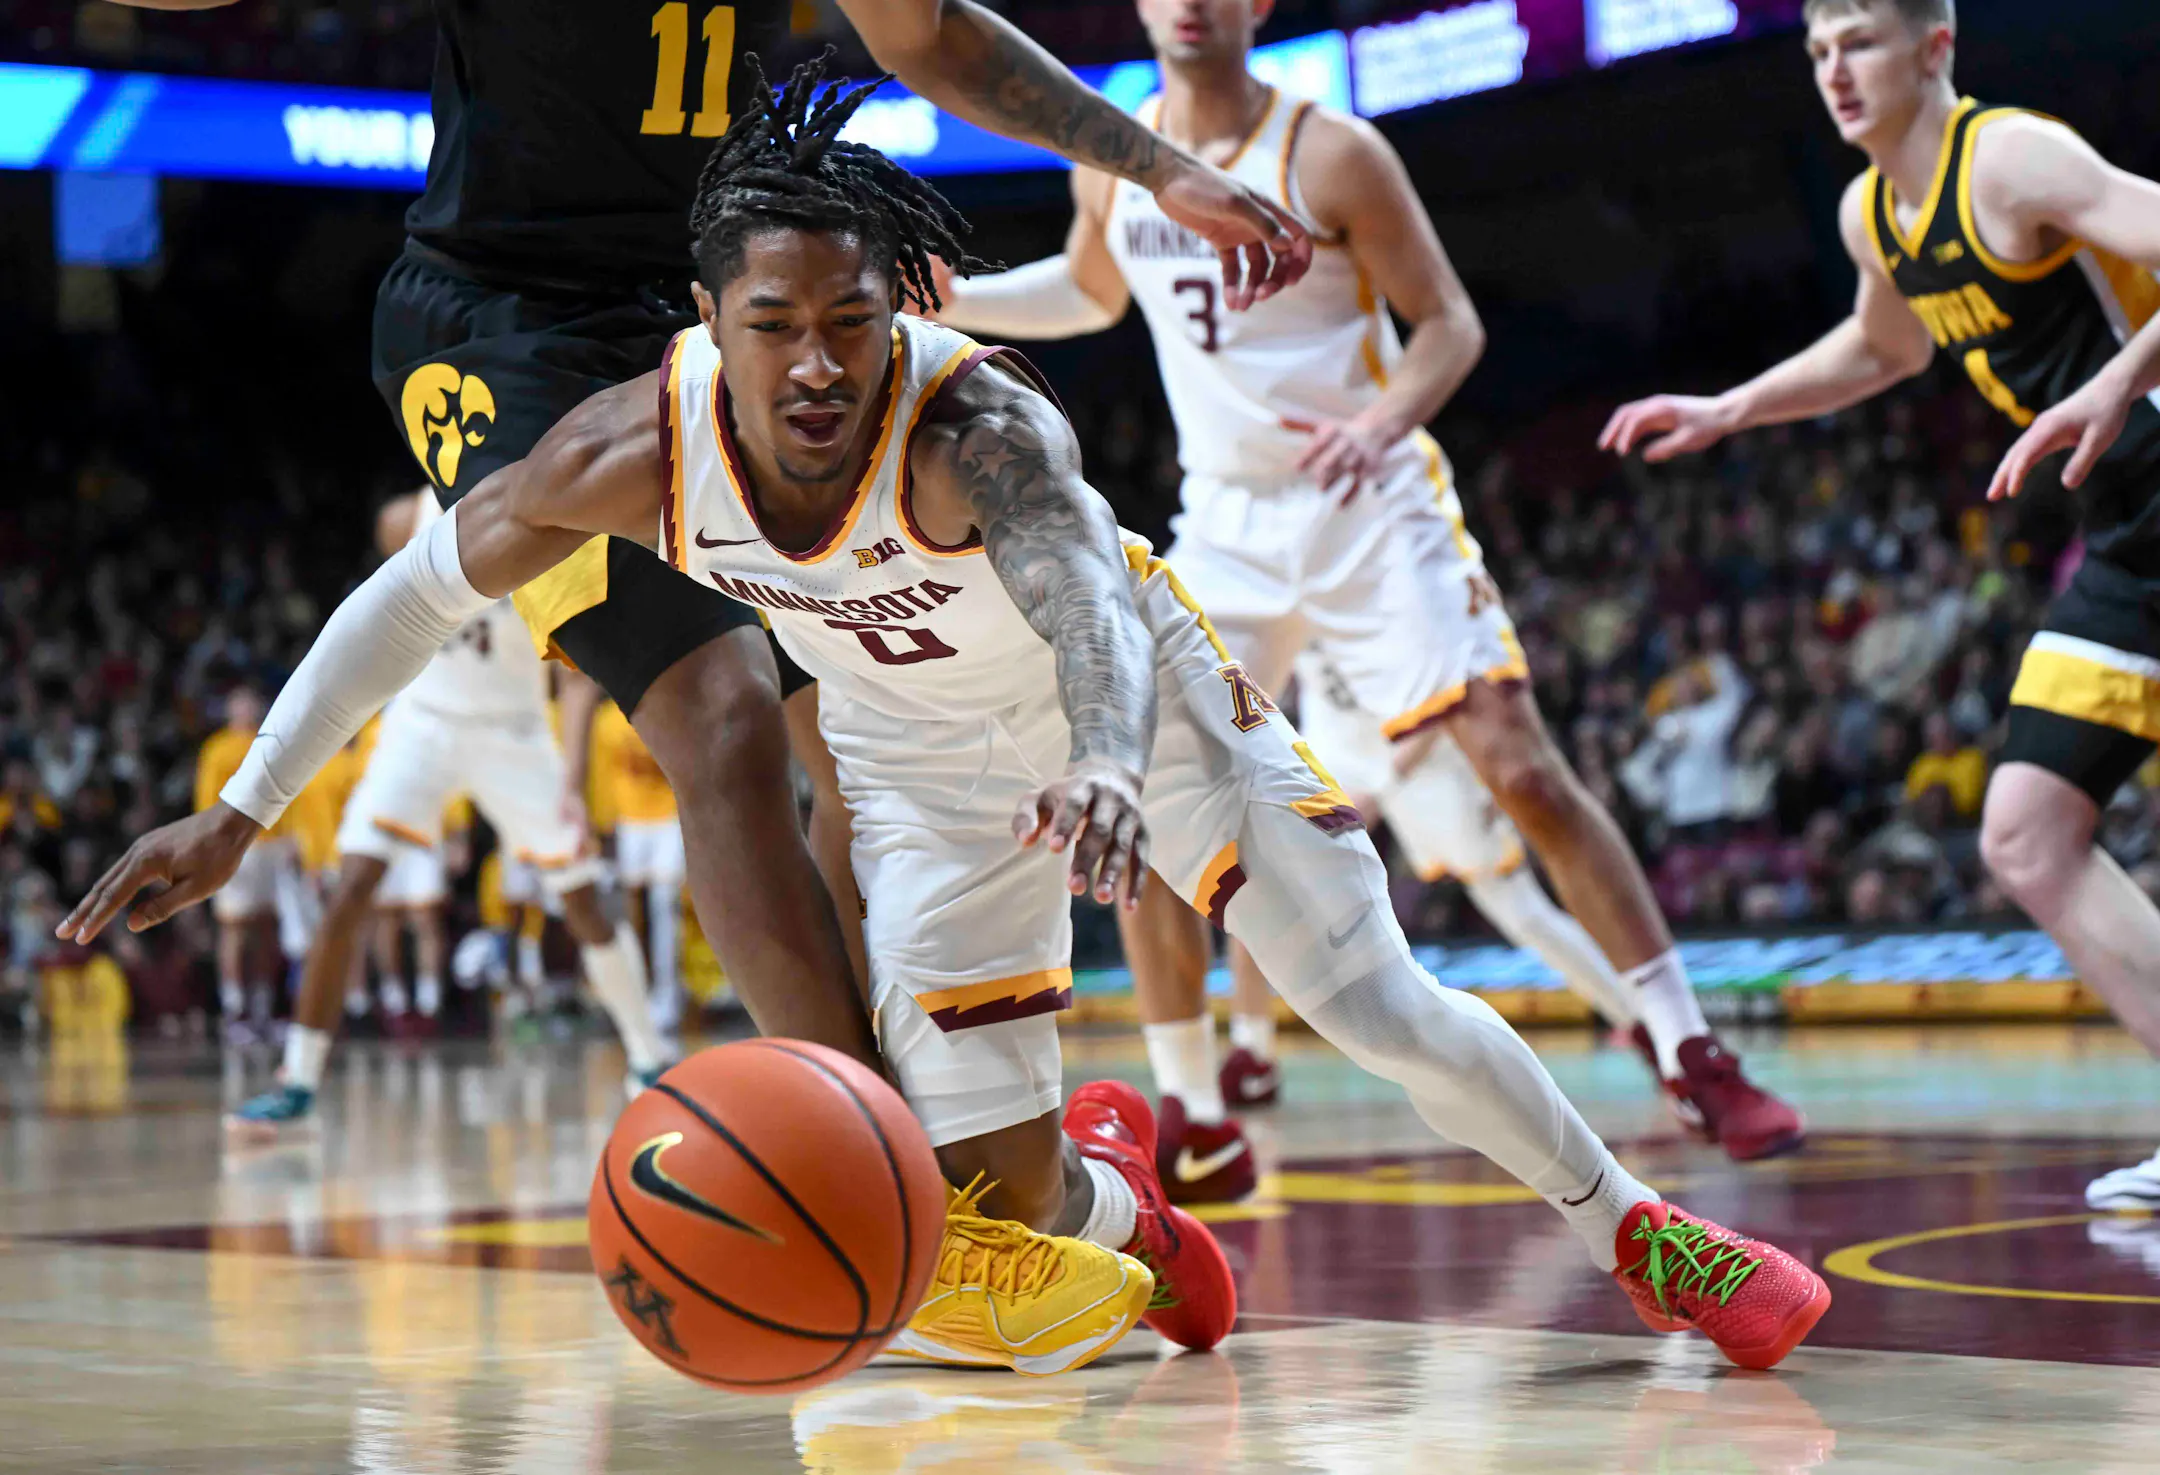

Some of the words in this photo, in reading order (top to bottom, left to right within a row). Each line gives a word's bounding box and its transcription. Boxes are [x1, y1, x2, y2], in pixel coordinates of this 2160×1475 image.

[640, 1, 735, 137] 11
[1173, 279, 1218, 353] 3
[709, 570, 964, 622] MINNESOTA
